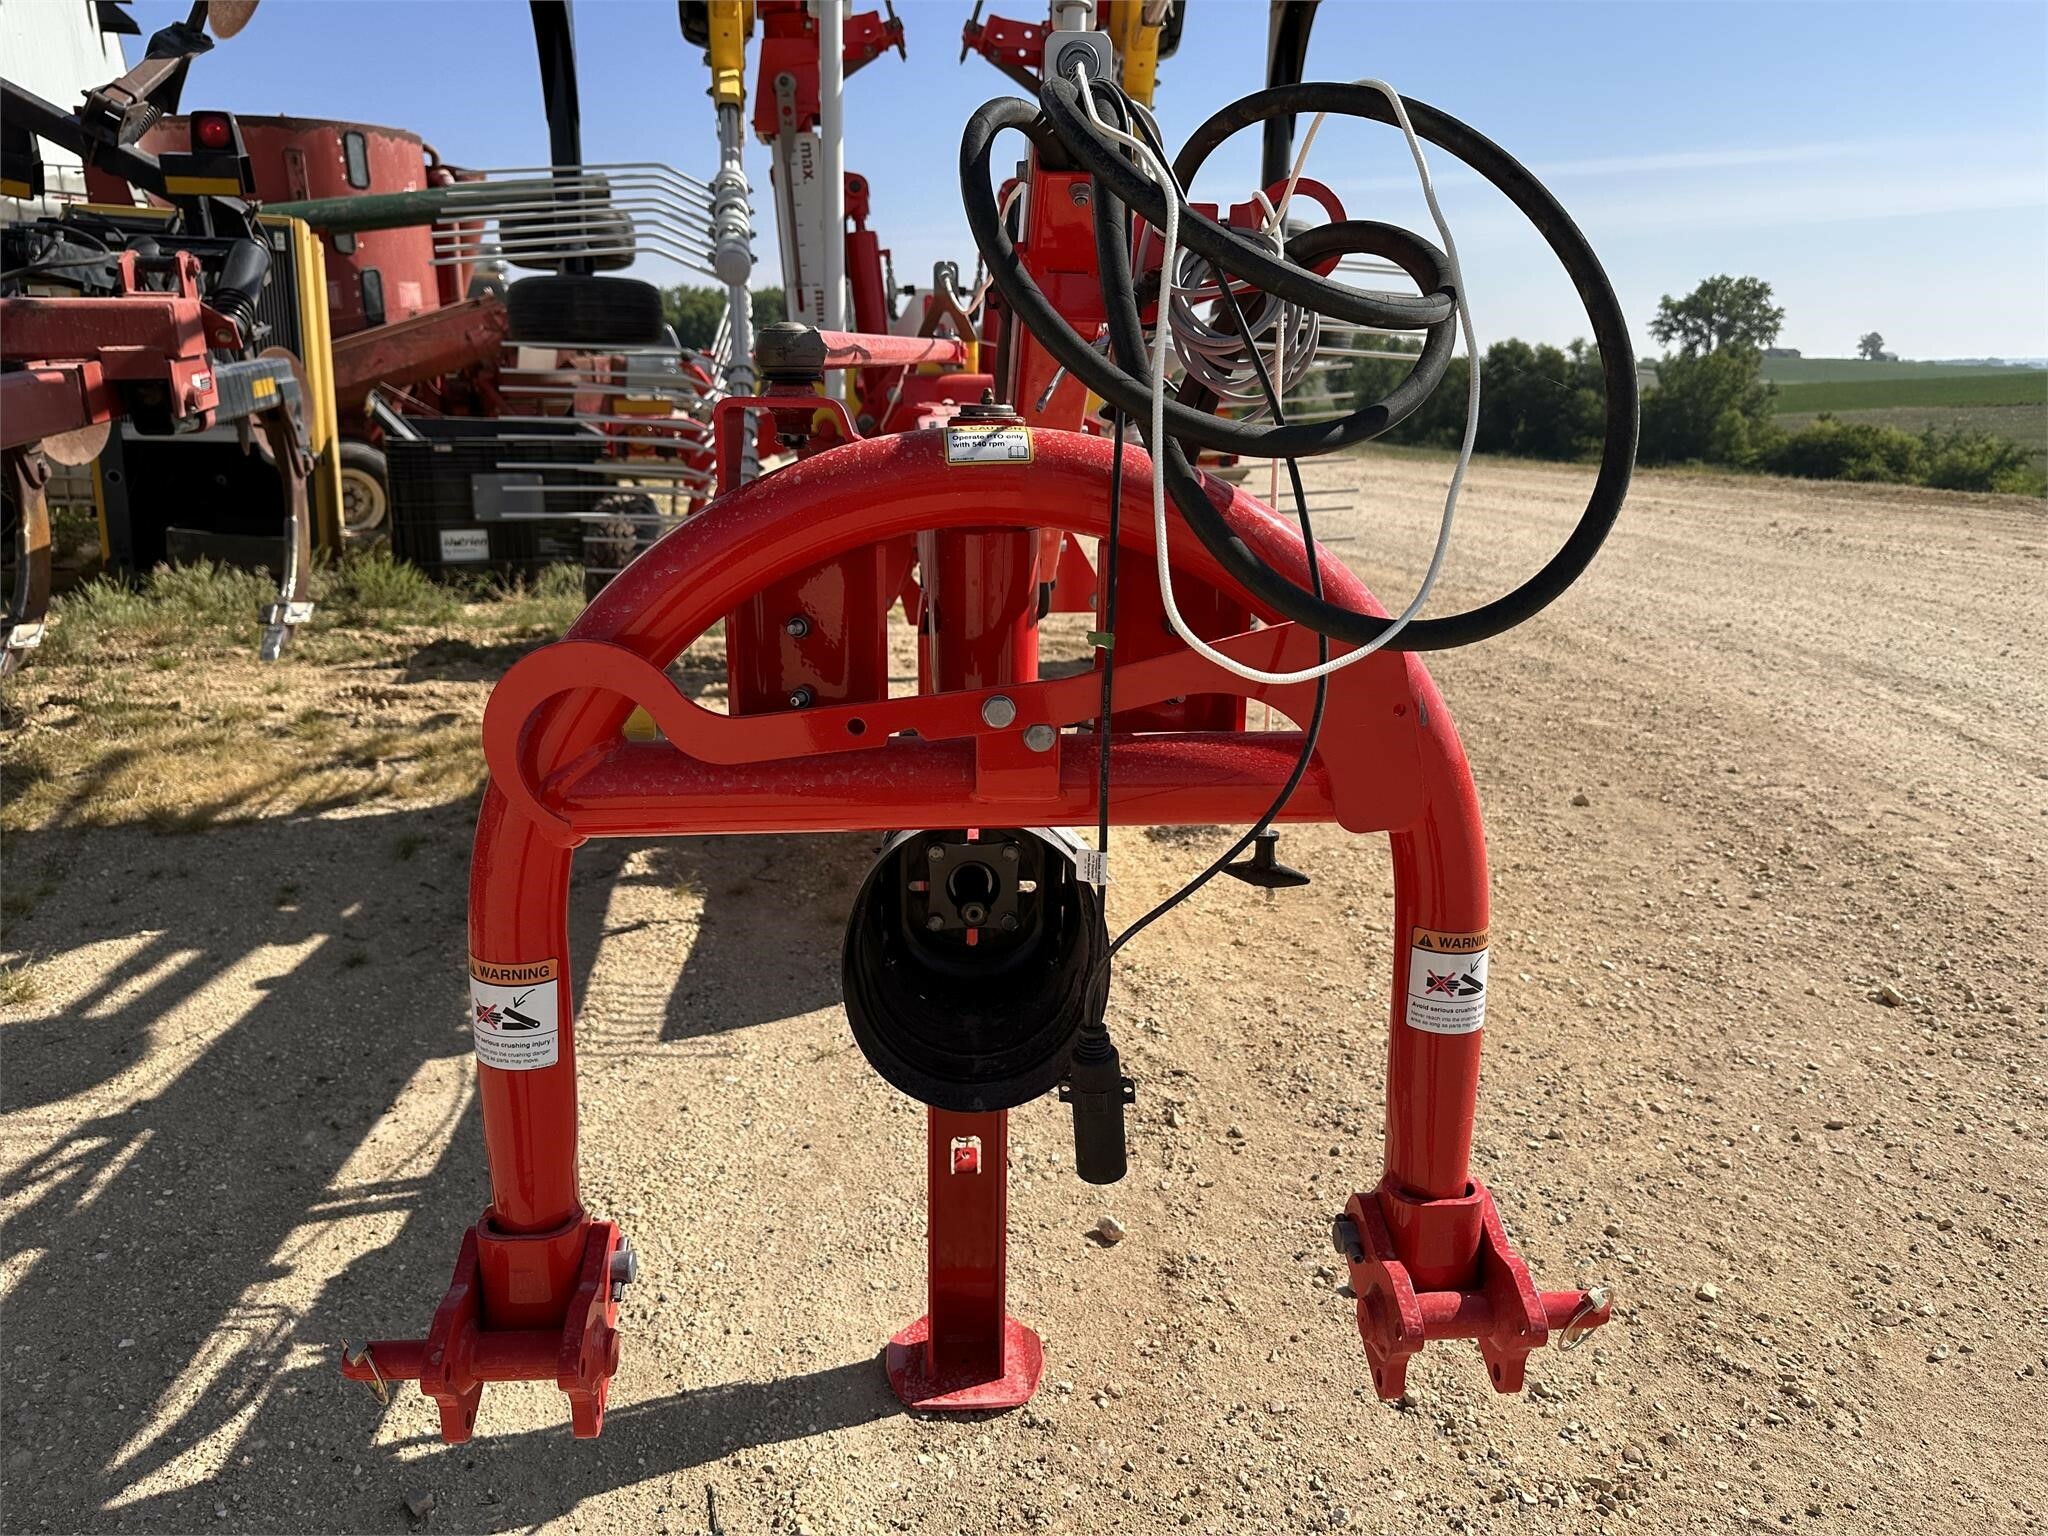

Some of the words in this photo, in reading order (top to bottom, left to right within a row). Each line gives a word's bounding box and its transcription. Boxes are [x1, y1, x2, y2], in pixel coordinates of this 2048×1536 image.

[800, 142, 814, 184] max.
[1439, 931, 1489, 949] WARNIN
[479, 965, 550, 981] WARNING
[1412, 1001, 1429, 1011] Avoid
[1430, 1006, 1454, 1014] serious
[1455, 1006, 1478, 1014] crushing
[532, 1039, 550, 1048] injury
